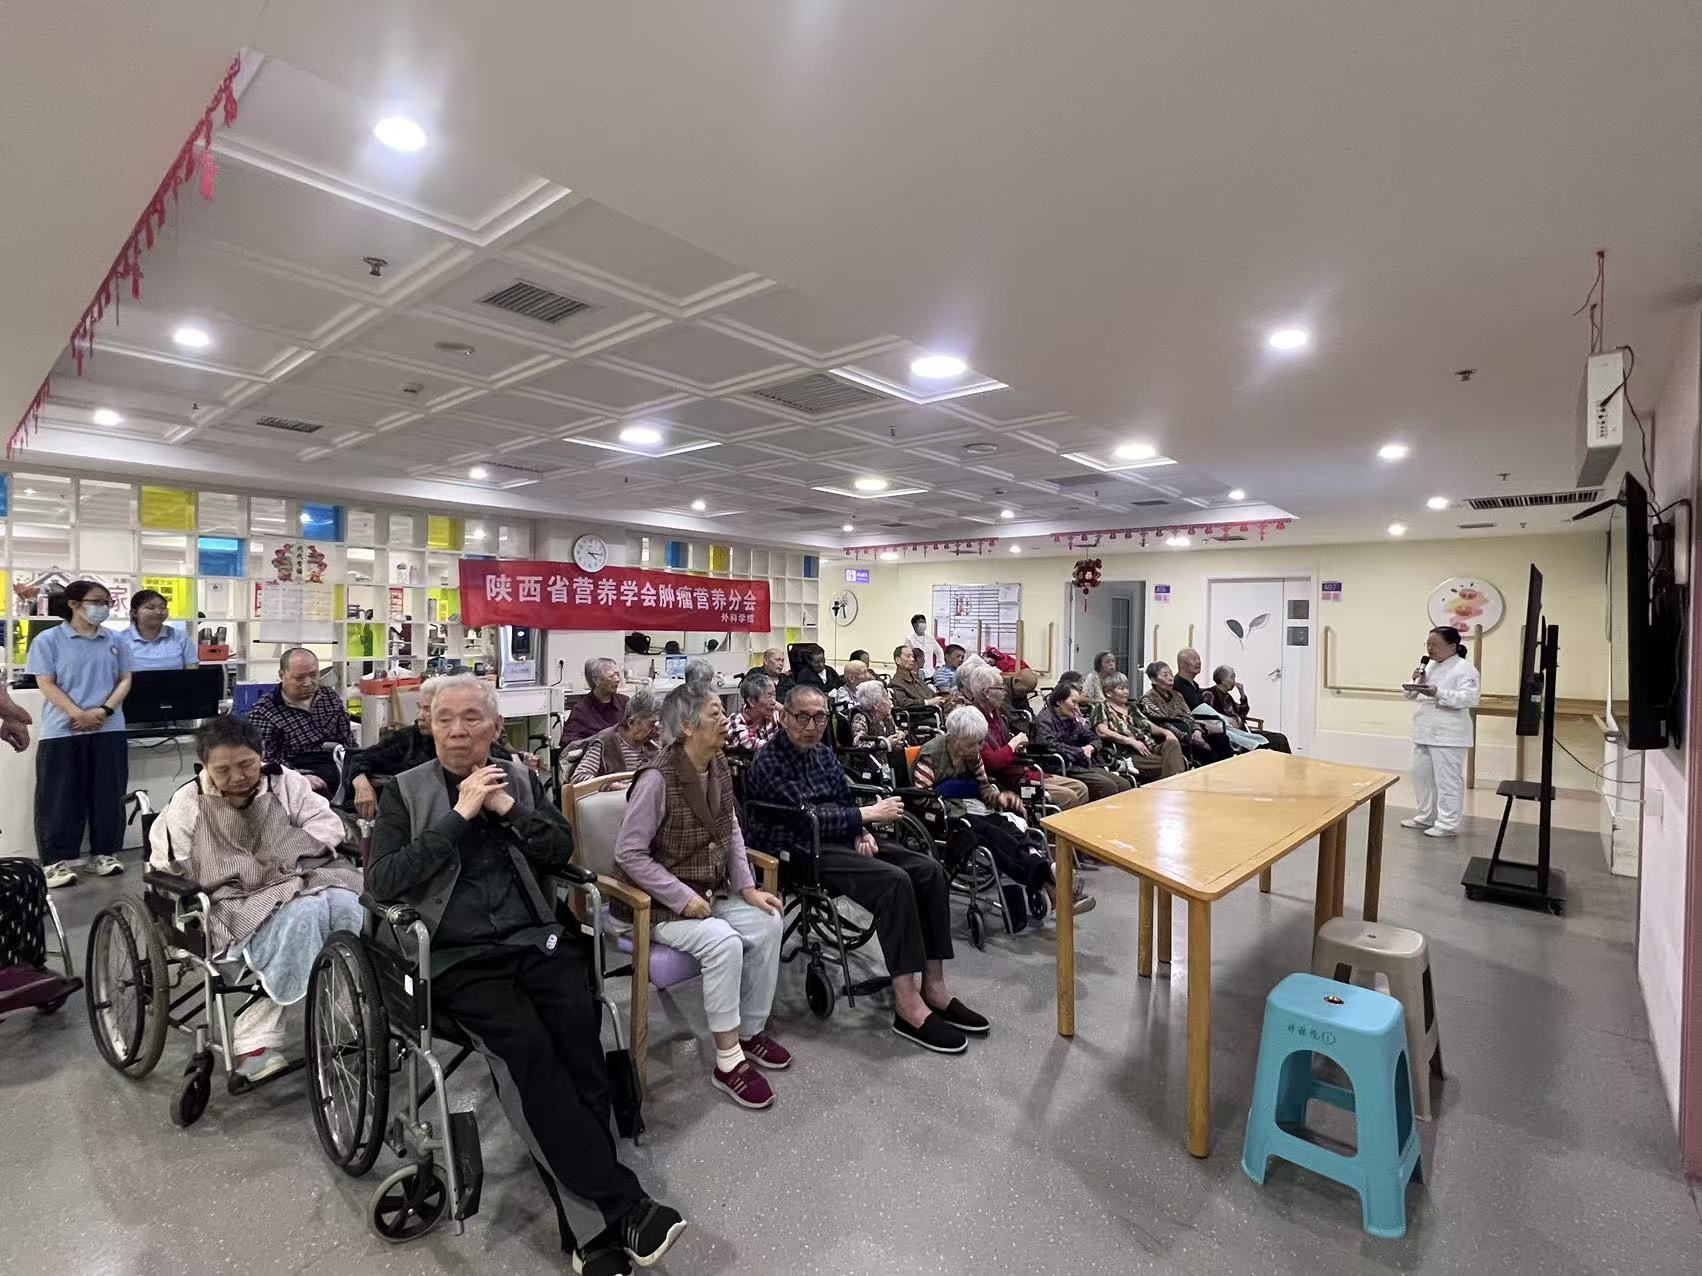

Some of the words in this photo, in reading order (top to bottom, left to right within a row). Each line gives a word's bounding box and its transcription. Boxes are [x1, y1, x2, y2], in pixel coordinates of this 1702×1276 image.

[485, 573, 757, 611] 陕西省营养学会肿瘤营养分会
